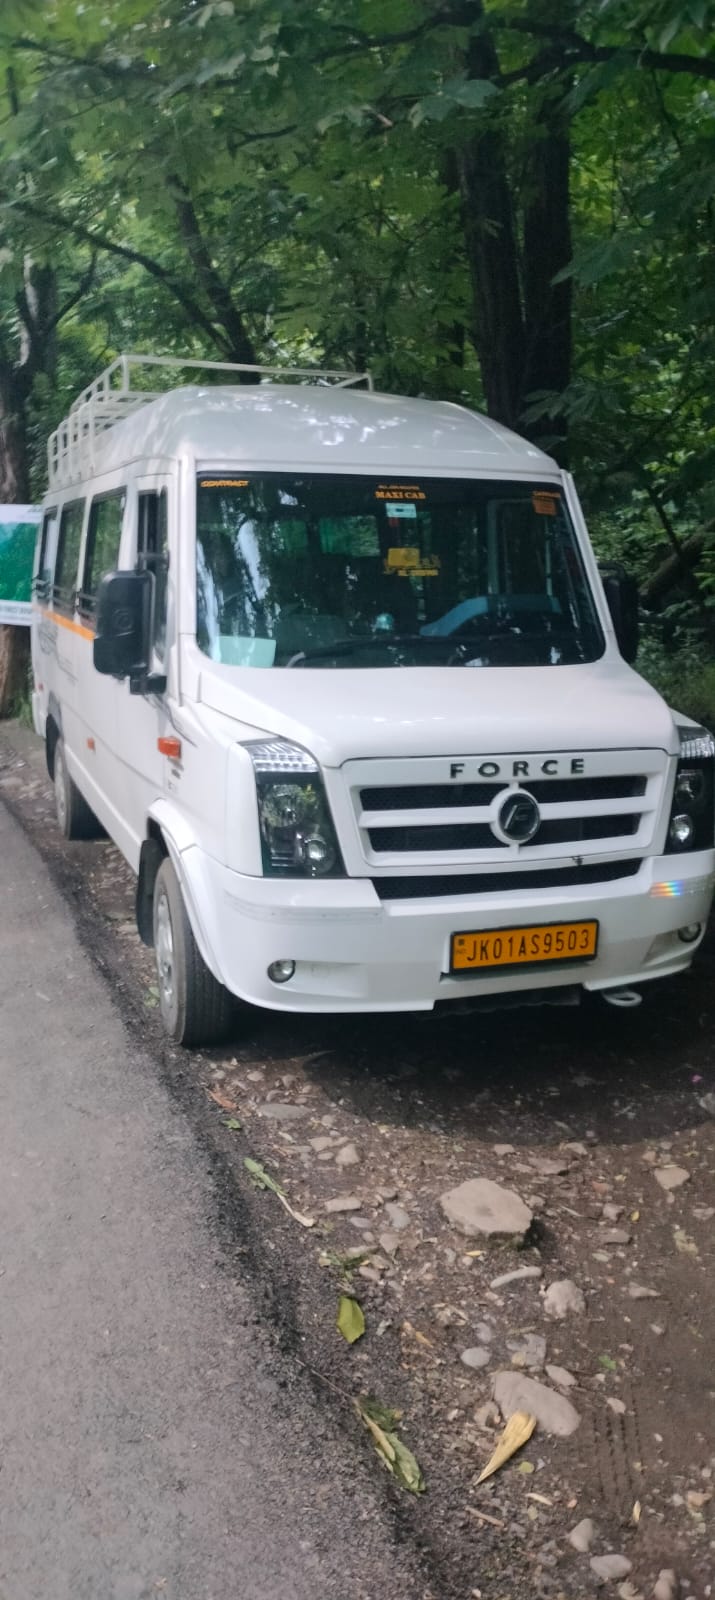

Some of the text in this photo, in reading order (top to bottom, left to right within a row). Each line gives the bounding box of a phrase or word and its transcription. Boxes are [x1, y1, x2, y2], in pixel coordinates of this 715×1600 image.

[375, 491, 403, 499] MAXI
[449, 758, 585, 779] FORCE
[466, 928, 589, 962] JK01AS9503
